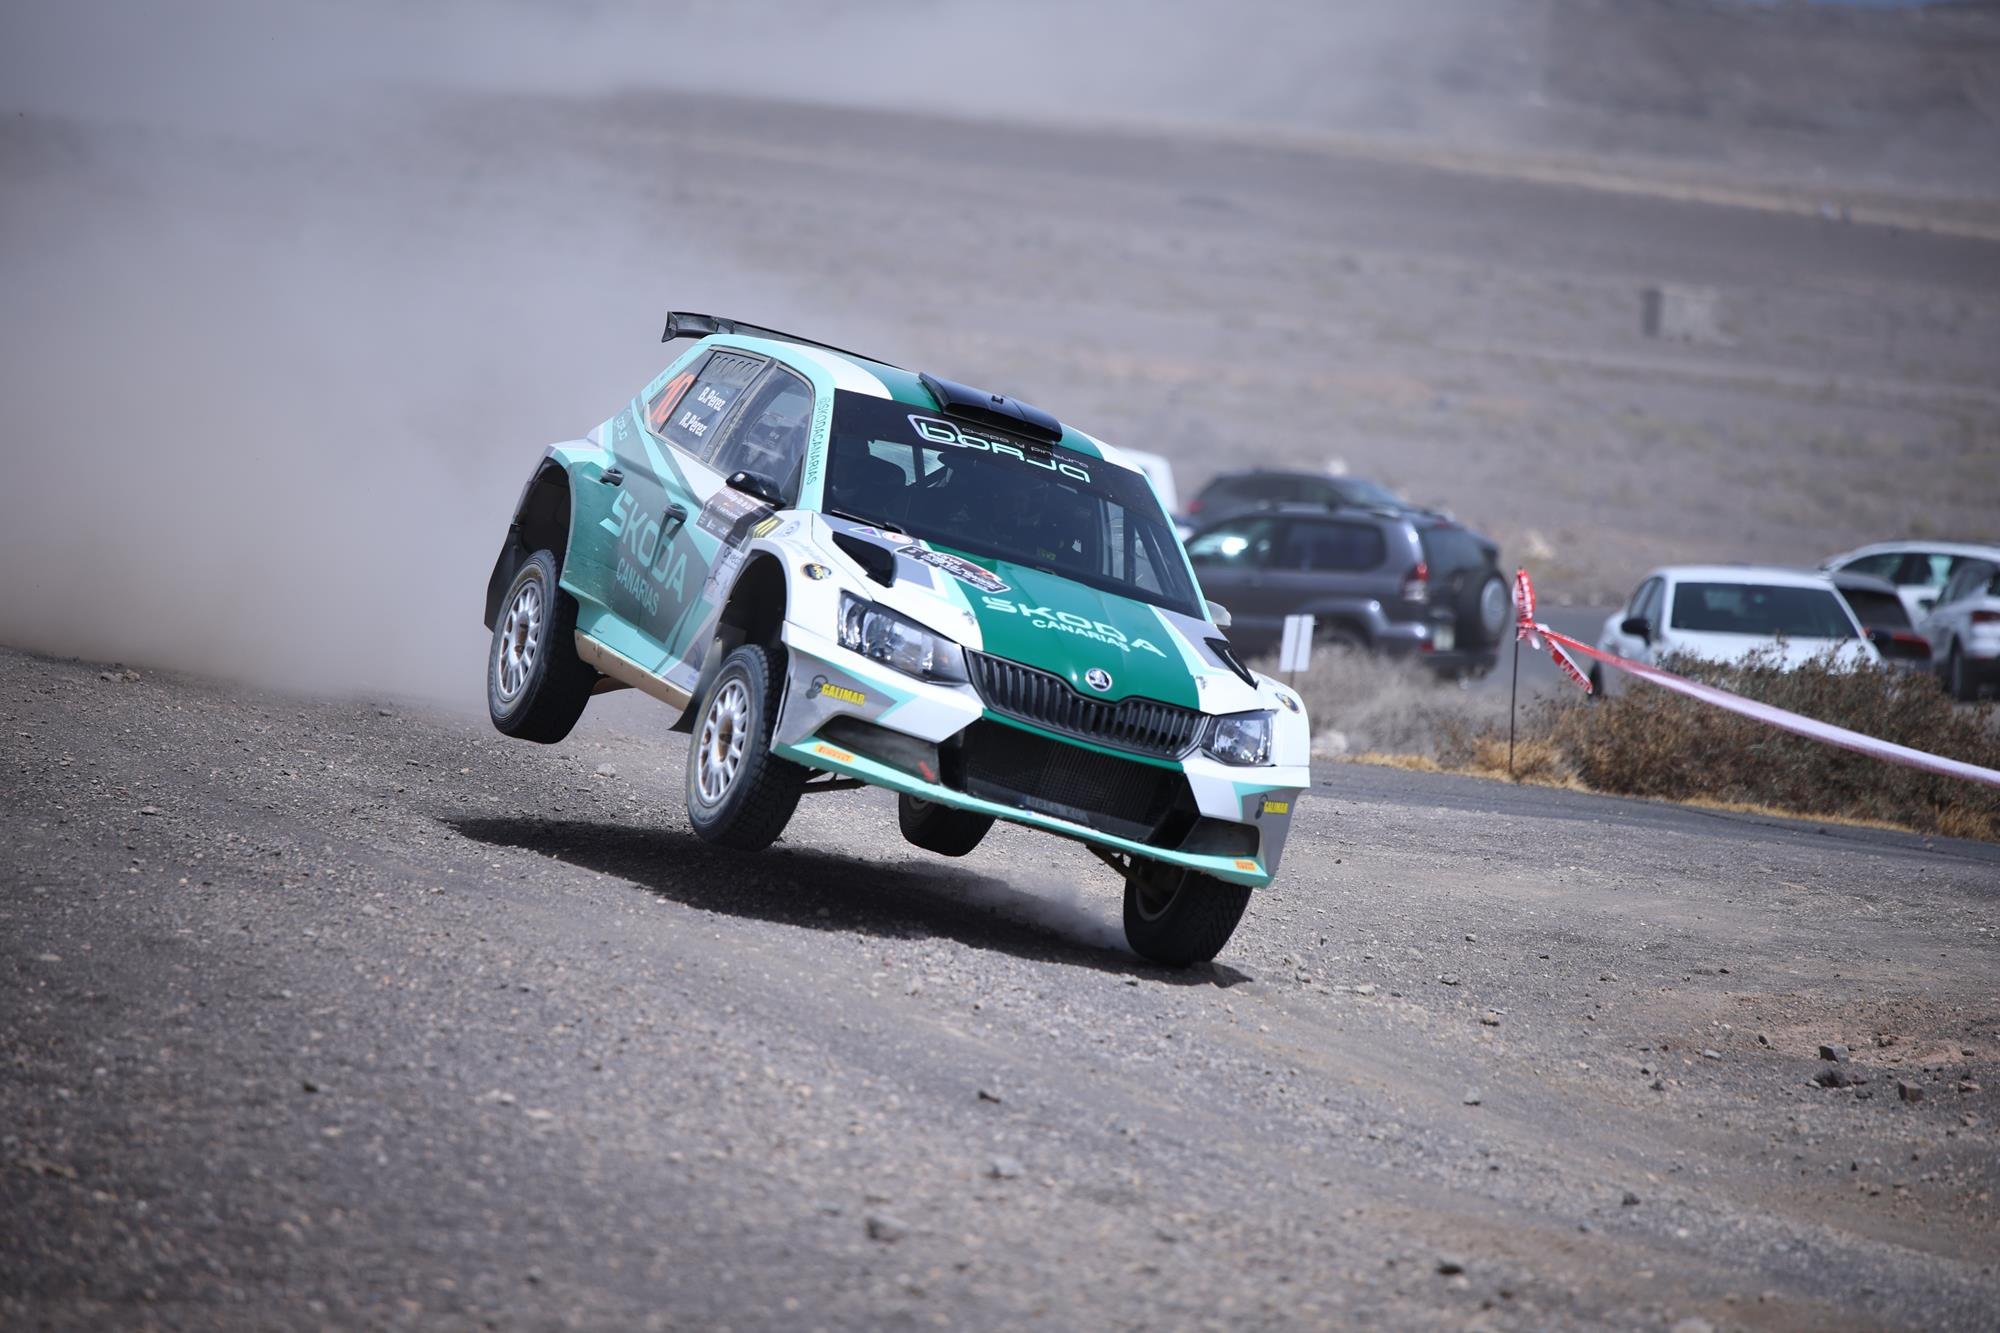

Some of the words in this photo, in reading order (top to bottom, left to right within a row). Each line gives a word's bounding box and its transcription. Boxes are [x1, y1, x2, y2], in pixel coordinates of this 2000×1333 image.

[698, 386, 726, 411] B.Pérez
[679, 411, 708, 437] R.Pérez
[616, 557, 660, 616] CANARIAS
[1032, 619, 1131, 652] CANARIAS
[821, 683, 866, 707] GALIMAR
